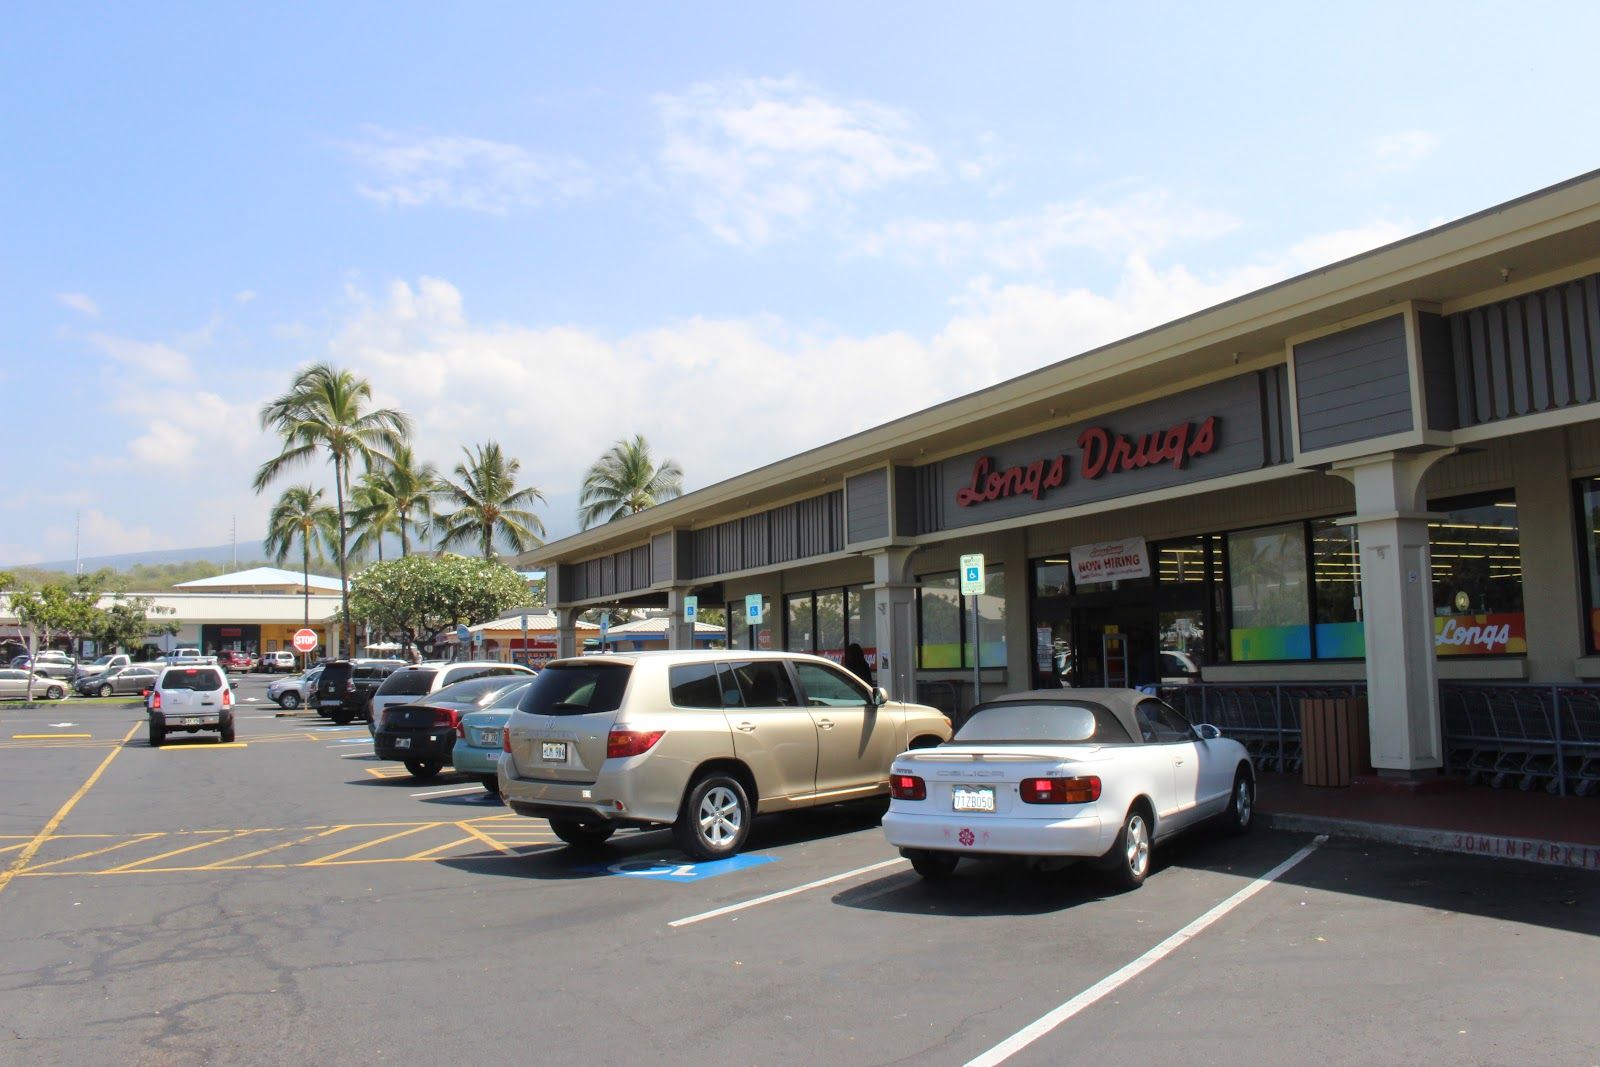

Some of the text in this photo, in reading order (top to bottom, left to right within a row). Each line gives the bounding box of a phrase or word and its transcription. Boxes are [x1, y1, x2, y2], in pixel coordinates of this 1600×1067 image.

[956, 415, 1216, 507] Longs Drugs
[1078, 558, 1102, 573] NOW
[1103, 553, 1140, 569] HIRING
[295, 635, 316, 645] STOP
[1434, 618, 1510, 651] Longs
